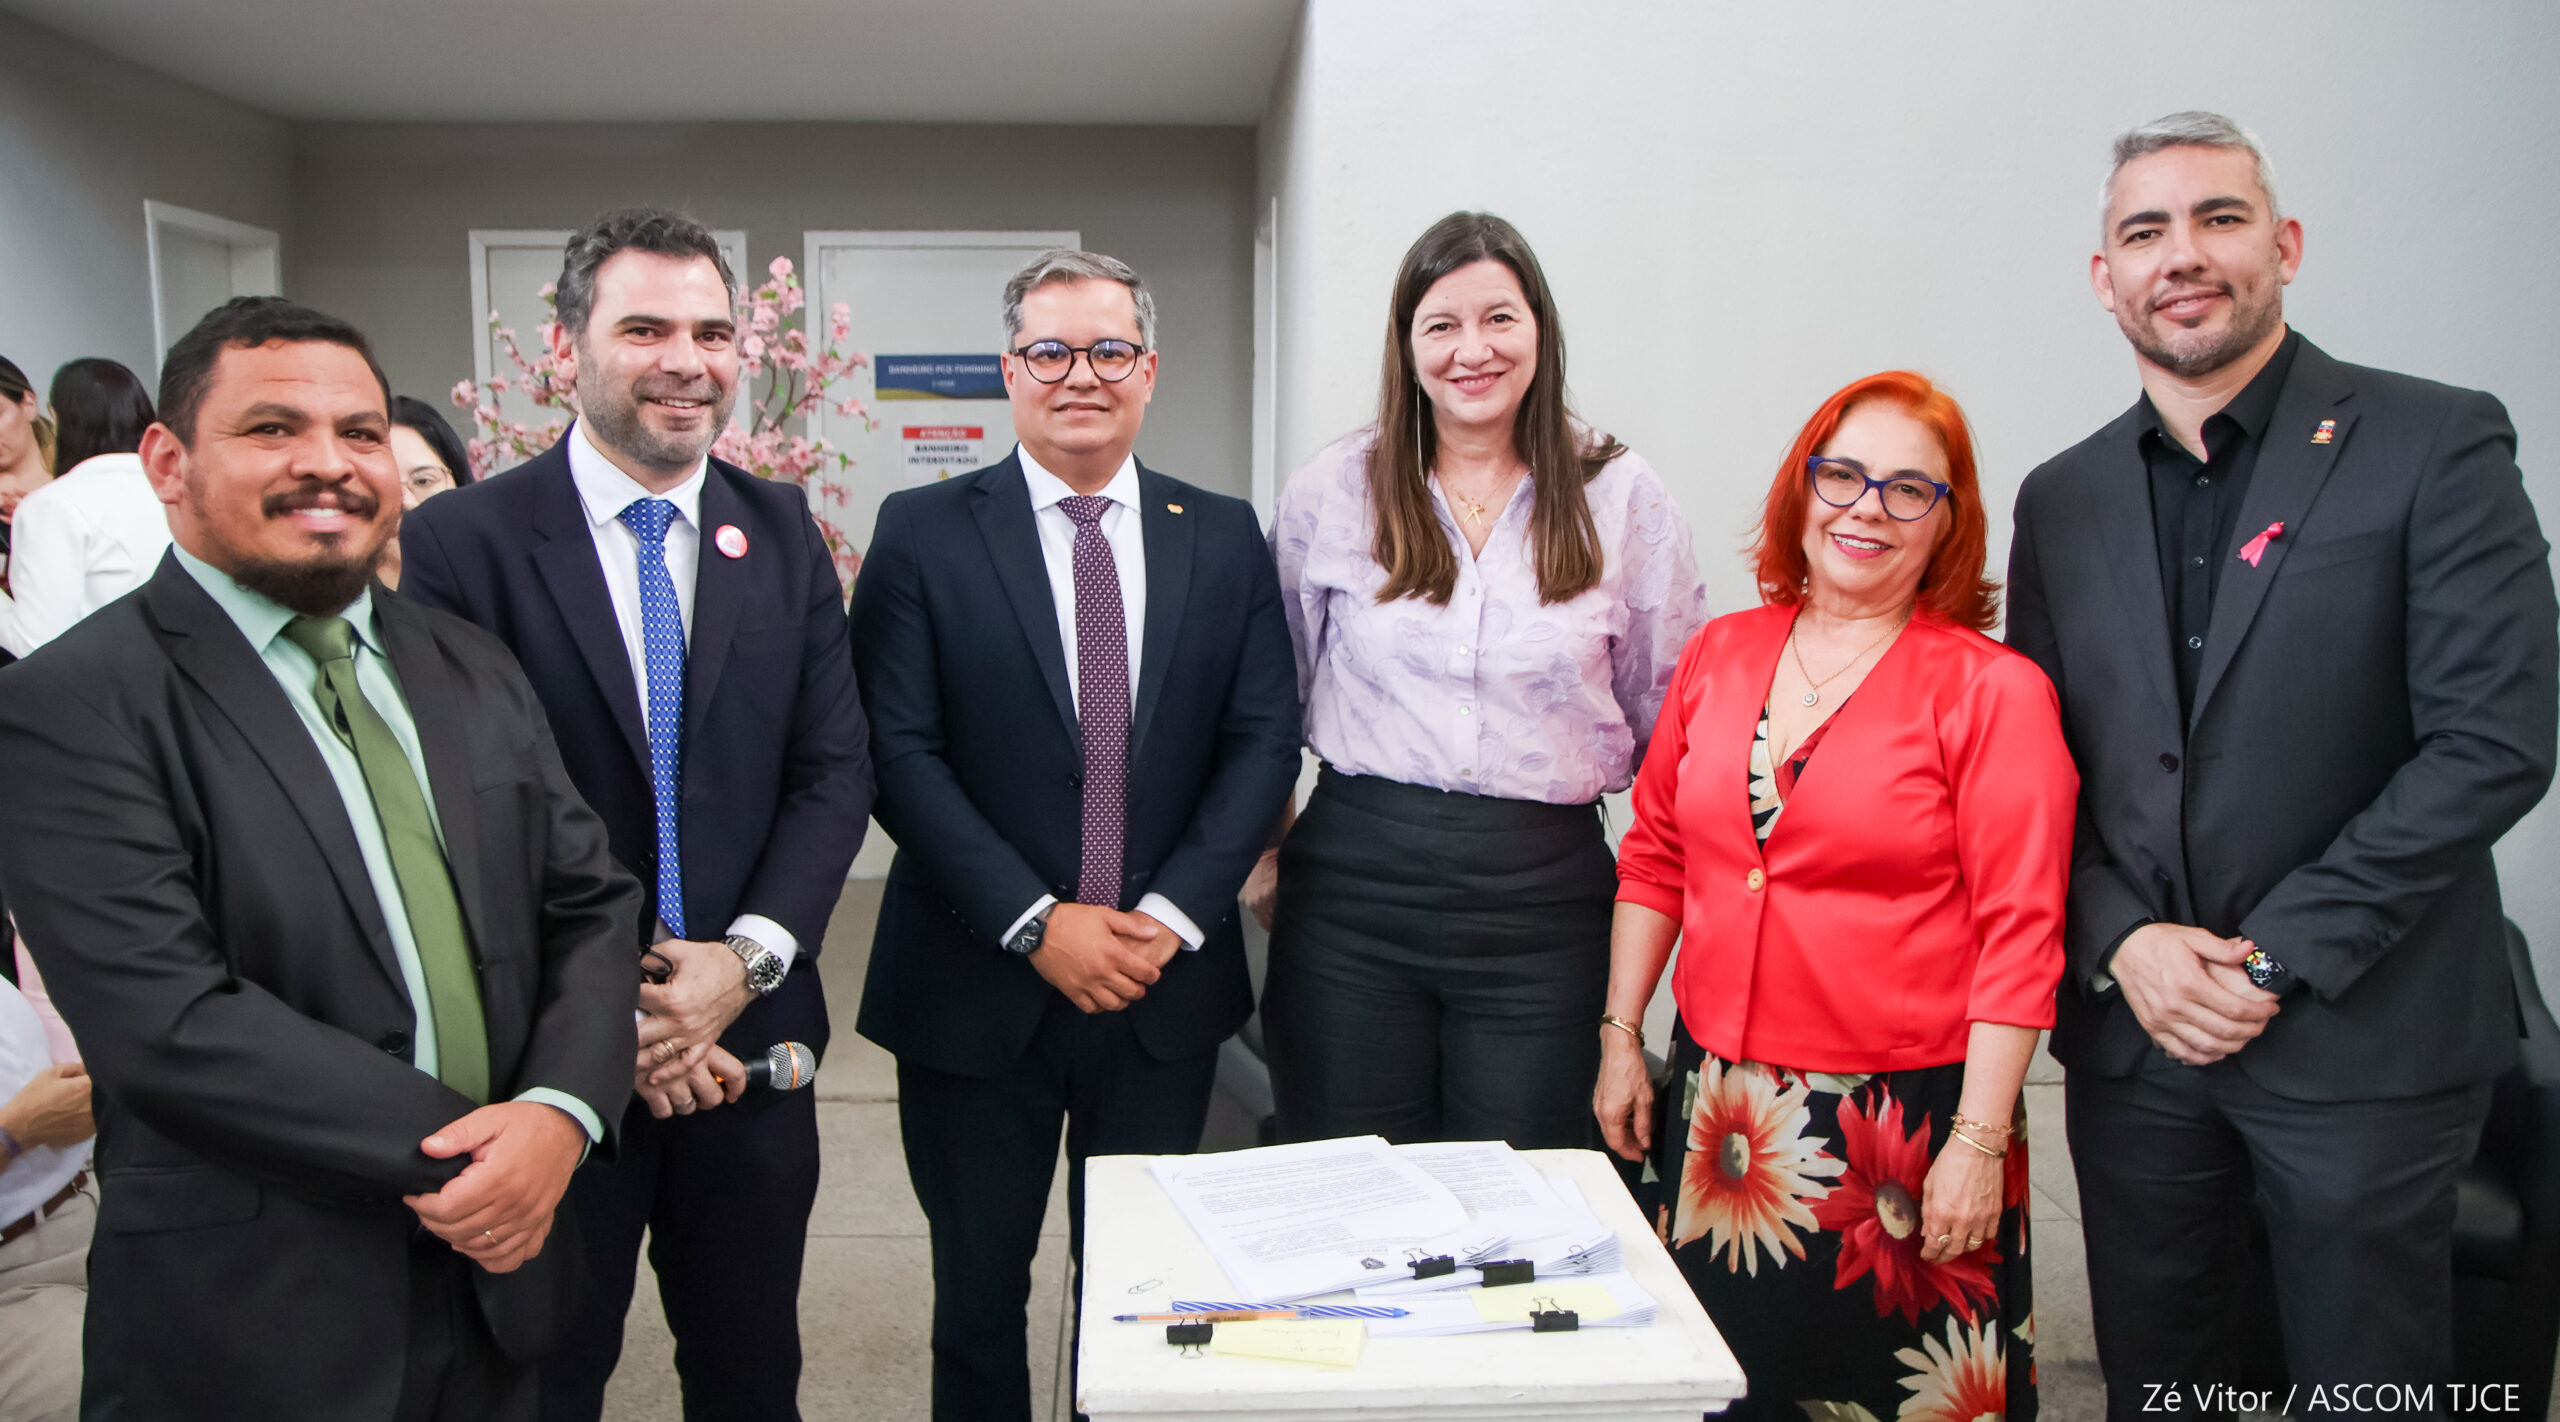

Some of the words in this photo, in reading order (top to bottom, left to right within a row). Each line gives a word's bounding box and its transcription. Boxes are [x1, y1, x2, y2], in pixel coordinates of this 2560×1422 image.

[888, 365, 933, 374] BANHEIRO
[955, 364, 997, 373] FEMININO
[920, 428, 966, 438] ATENÇÃO
[915, 445, 968, 453] BANHEIRO
[909, 456, 978, 464] INTERDITADO
